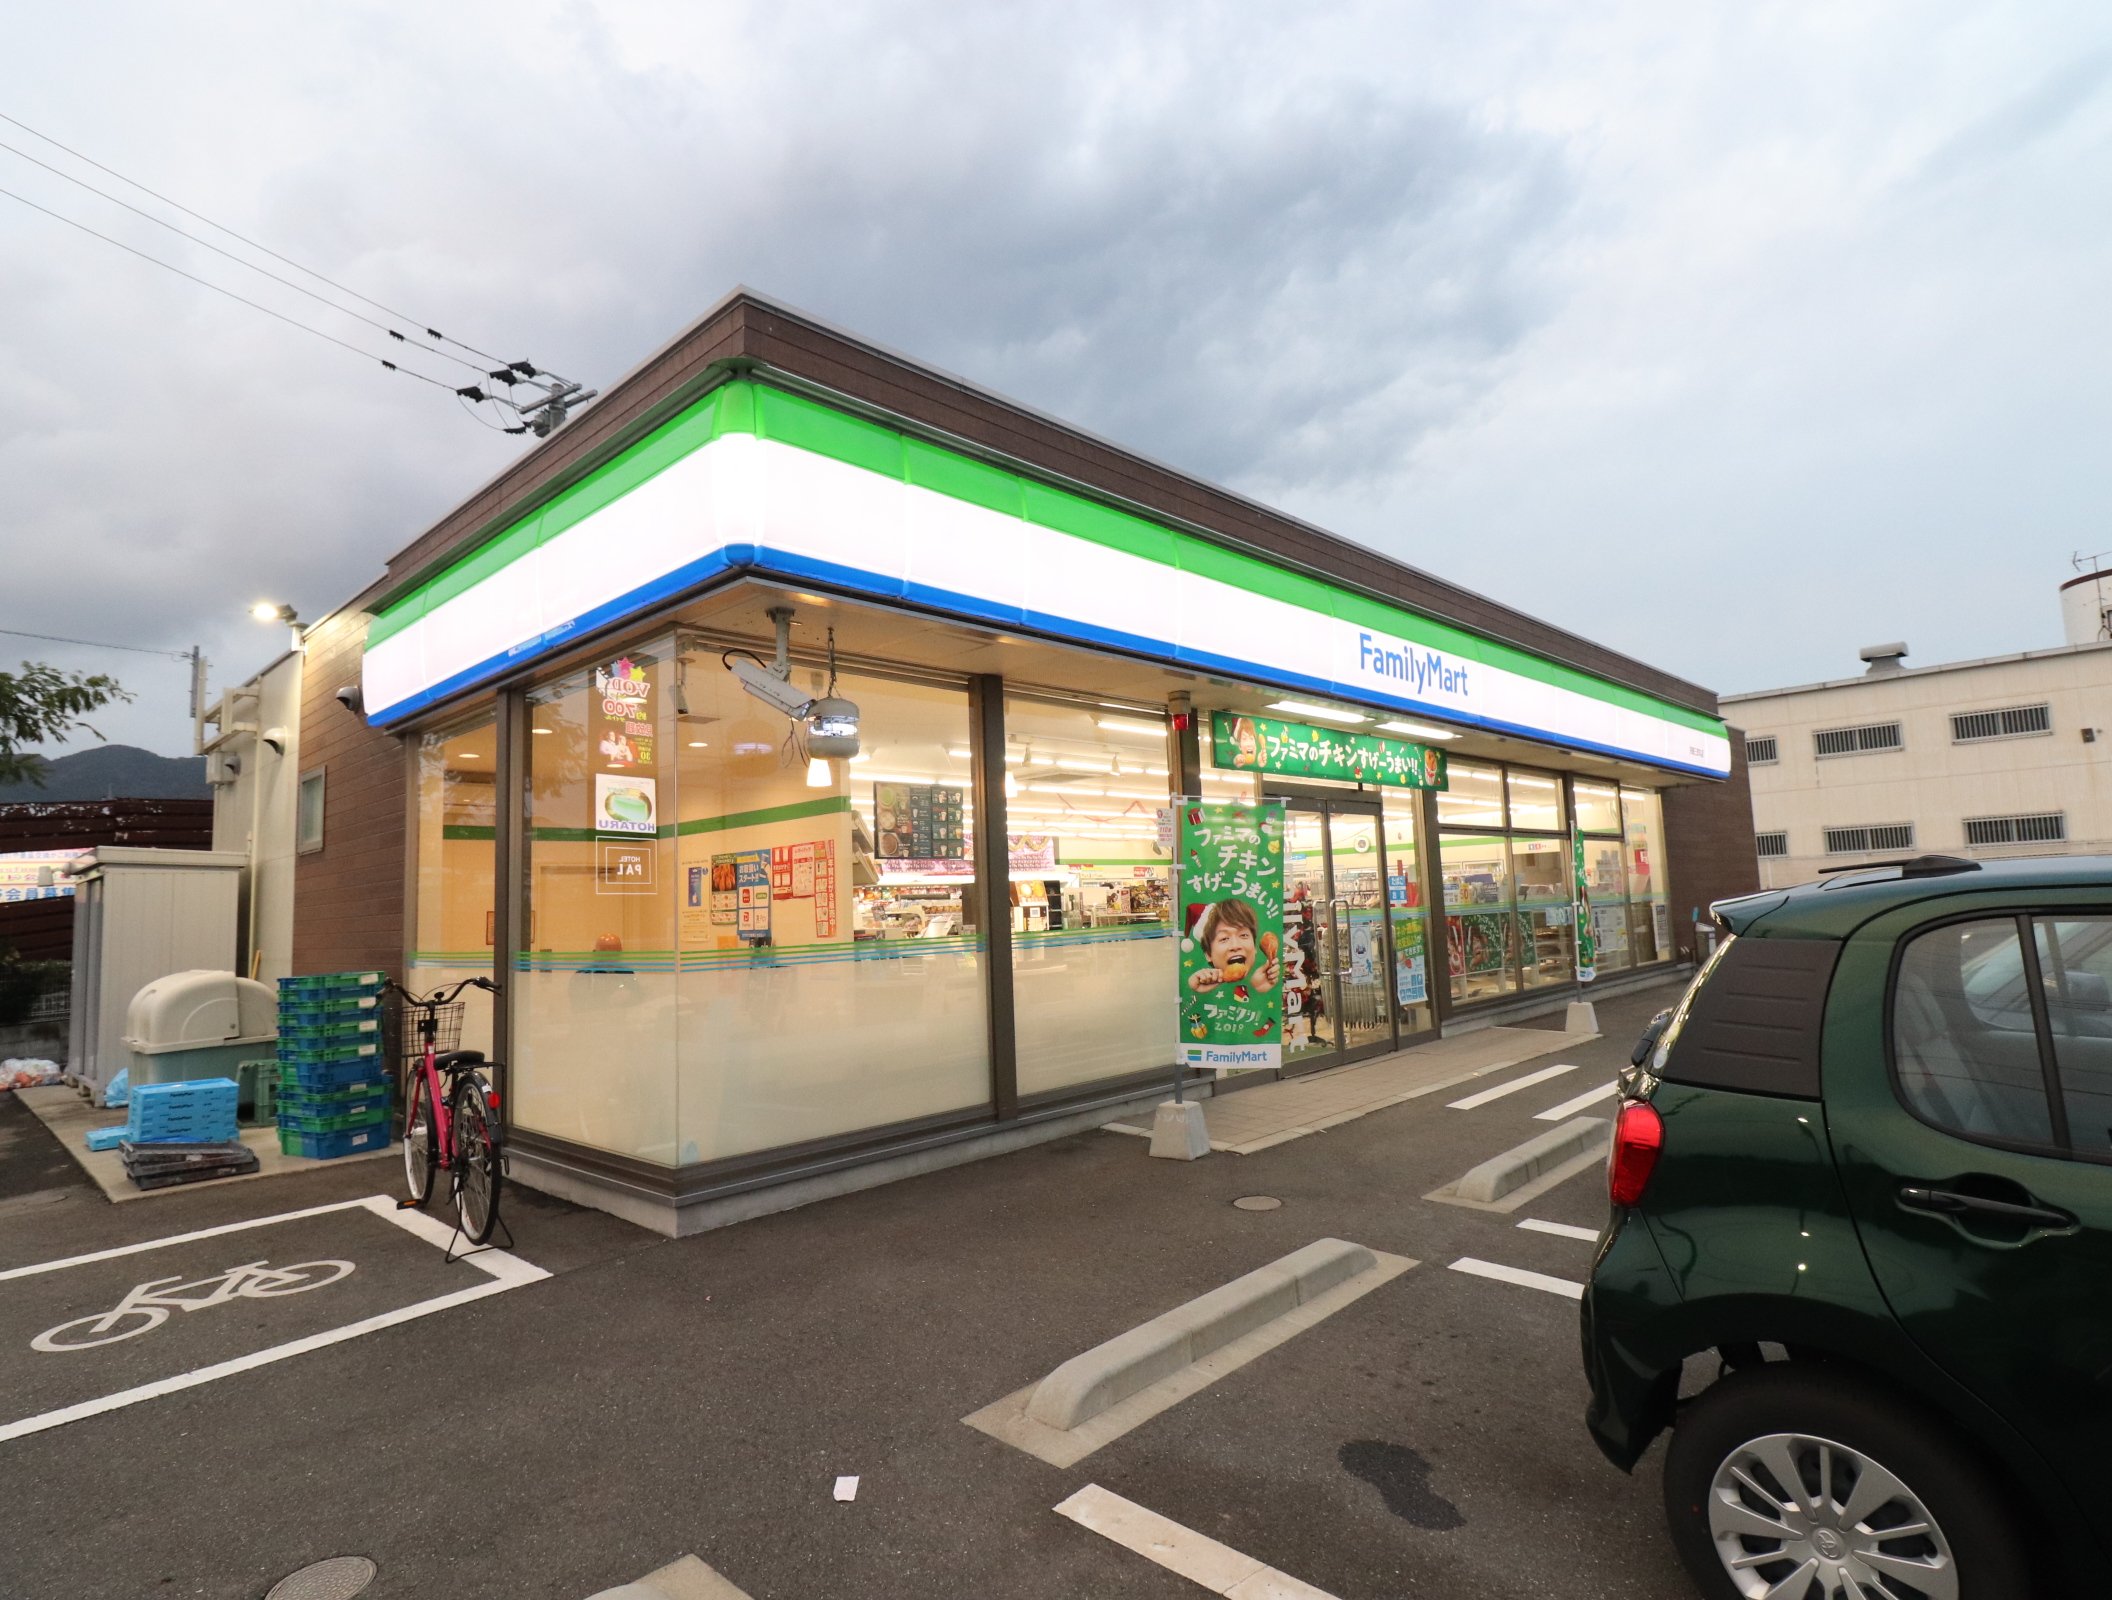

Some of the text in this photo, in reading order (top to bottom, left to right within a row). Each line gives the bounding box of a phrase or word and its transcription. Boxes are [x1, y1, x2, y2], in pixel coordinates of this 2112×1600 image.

[1359, 633, 1468, 695] FamilyMart
[1194, 826, 1261, 847] ファミマの
[1218, 844, 1276, 876] チキン
[1206, 1050, 1267, 1063] FamilyMart
